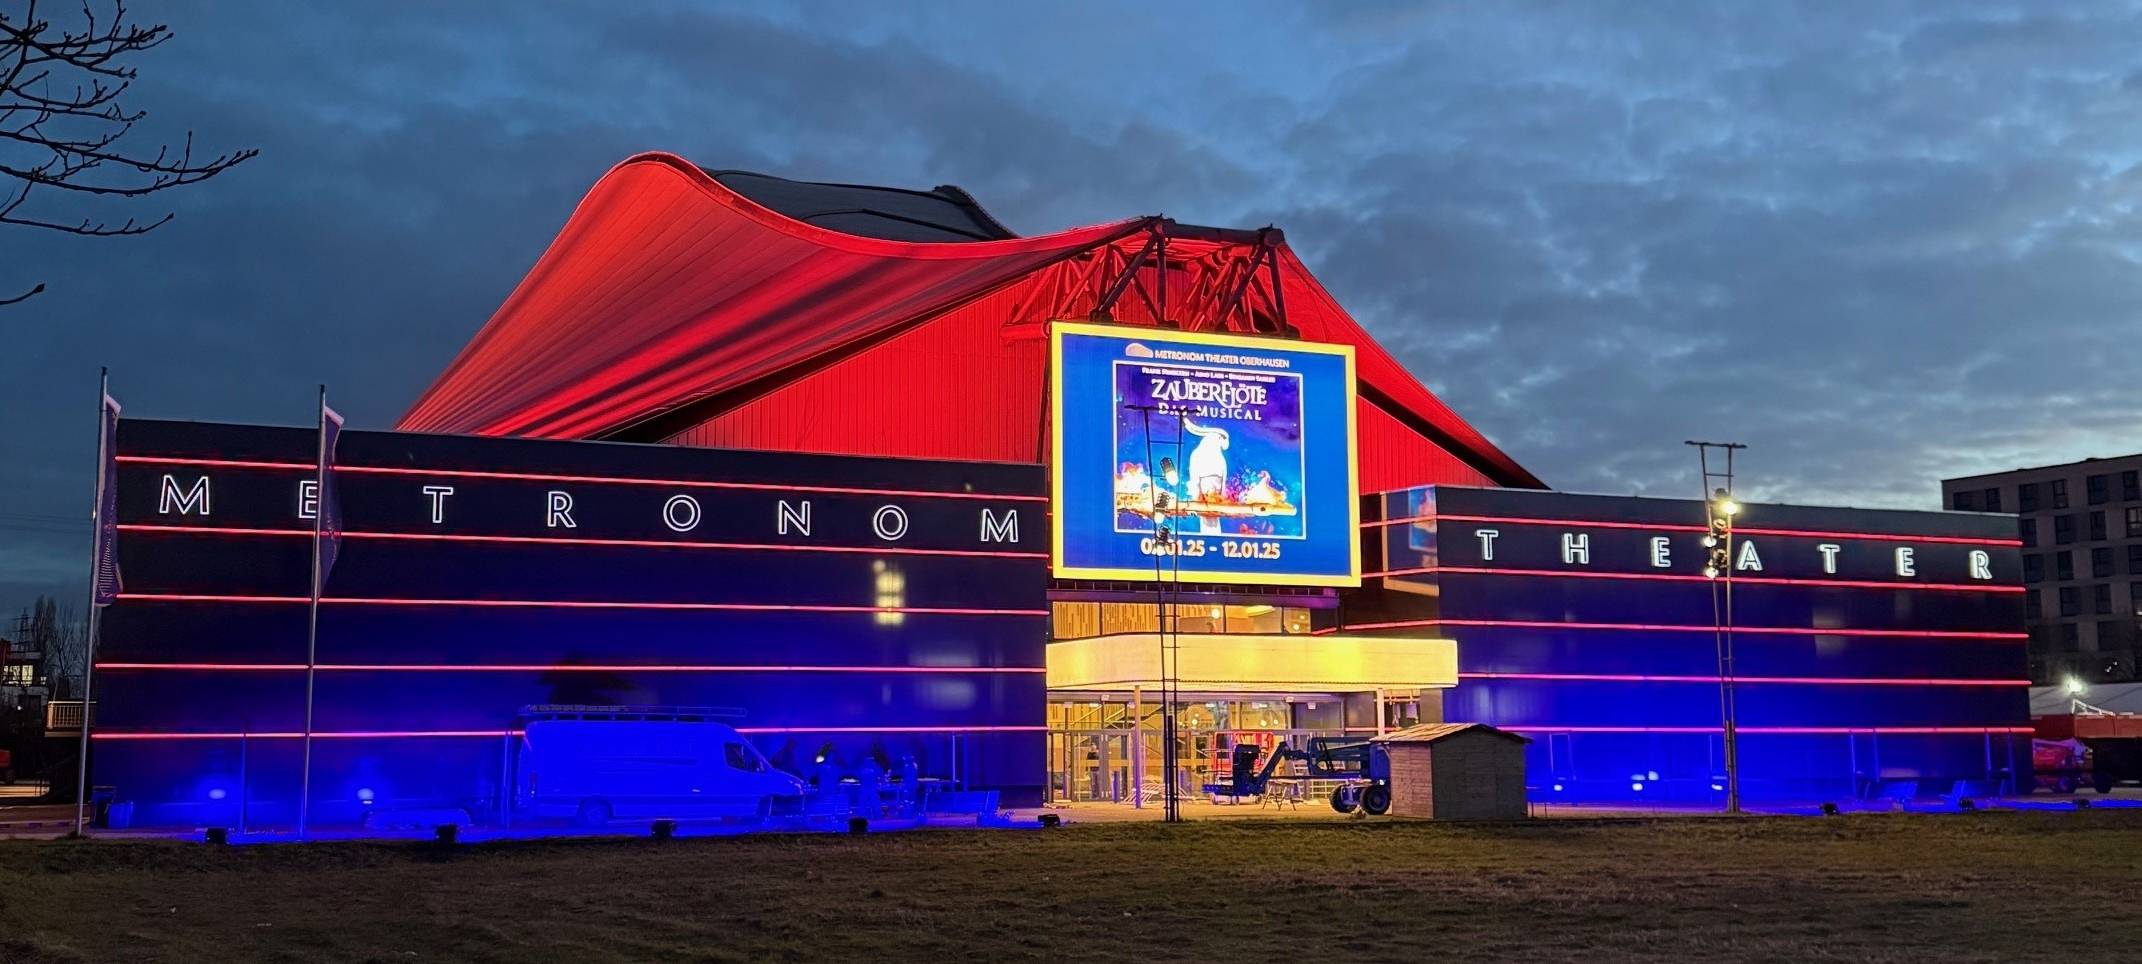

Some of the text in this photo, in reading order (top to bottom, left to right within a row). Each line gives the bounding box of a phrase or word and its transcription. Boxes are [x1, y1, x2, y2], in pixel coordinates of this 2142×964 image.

[1154, 350, 1290, 369] METRONOM THEATER OBERHAUSEN
[1151, 378, 1268, 408] ZAUBERFLÖTE
[1196, 404, 1262, 421] MUSICAL
[159, 475, 1019, 543] METRONOM
[1221, 540, 1281, 560] 12.01.25
[1475, 528, 1993, 580] THEATER
